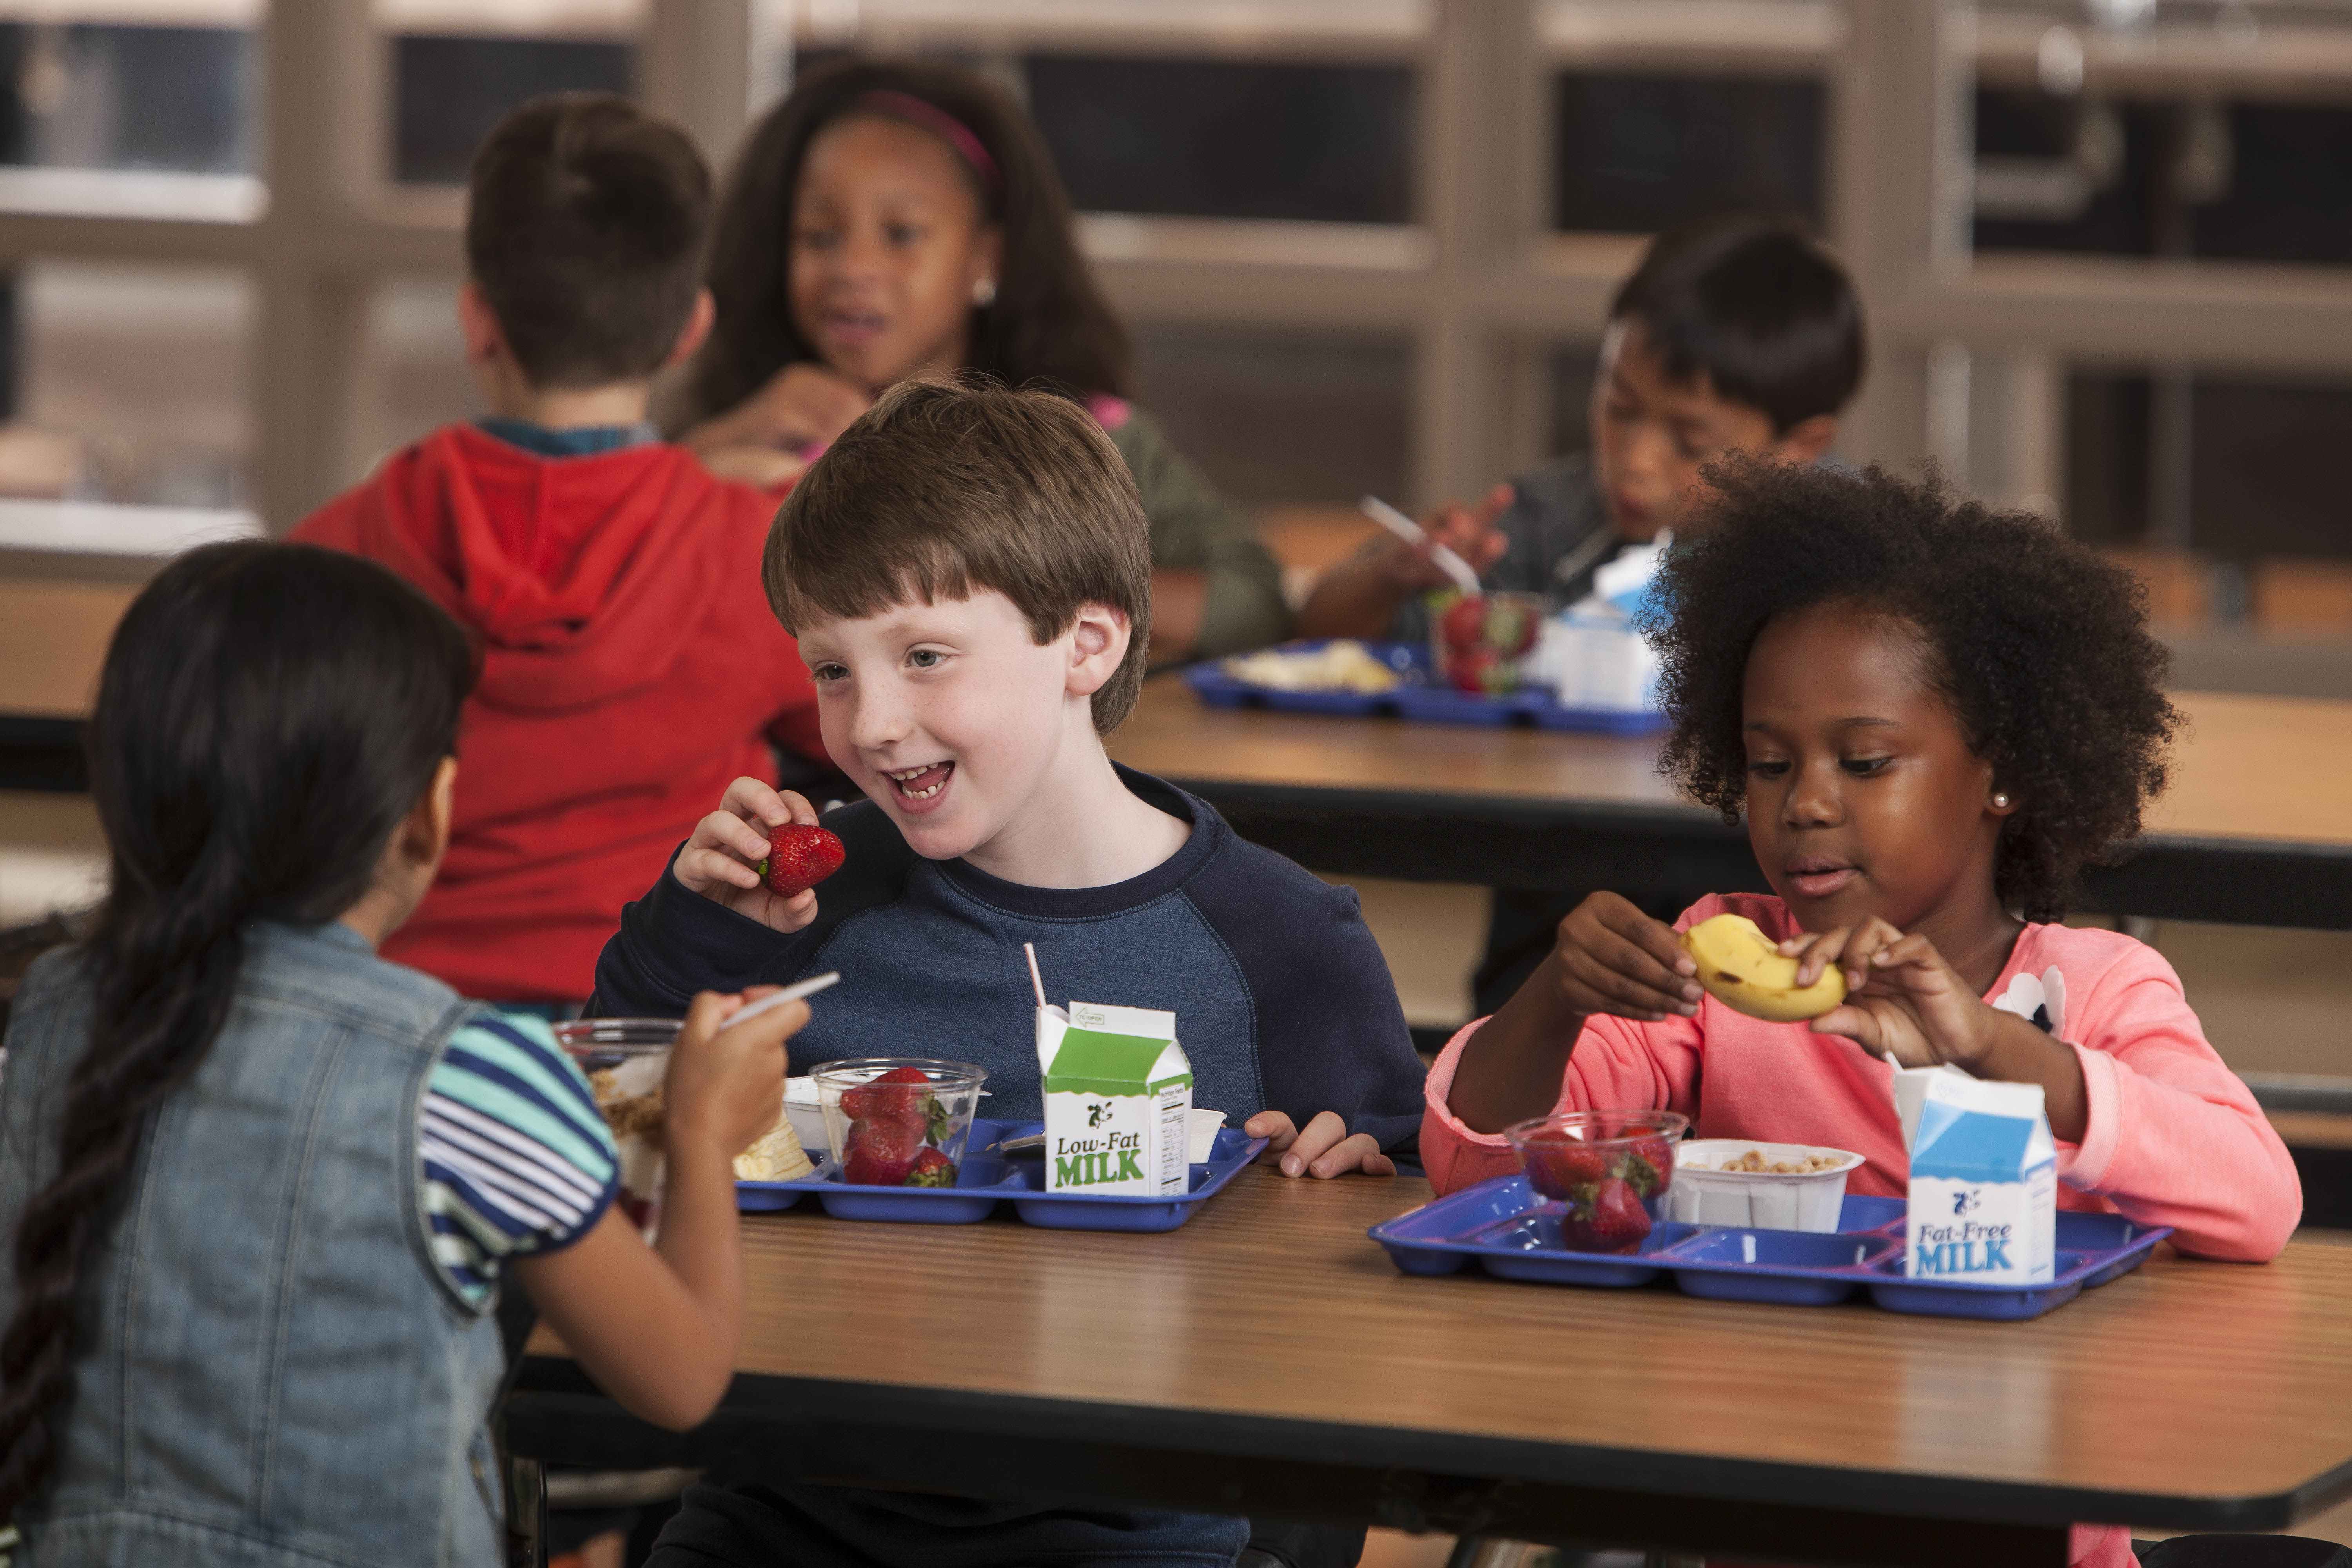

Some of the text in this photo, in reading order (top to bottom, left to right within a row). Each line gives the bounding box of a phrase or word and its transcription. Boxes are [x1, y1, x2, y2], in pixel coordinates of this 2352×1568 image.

[1057, 1132, 1140, 1155] Low-Fat
[1055, 1149, 1144, 1188] MILK
[1919, 1222, 2012, 1243] Fat-Free
[1916, 1239, 2014, 1276] MILK
